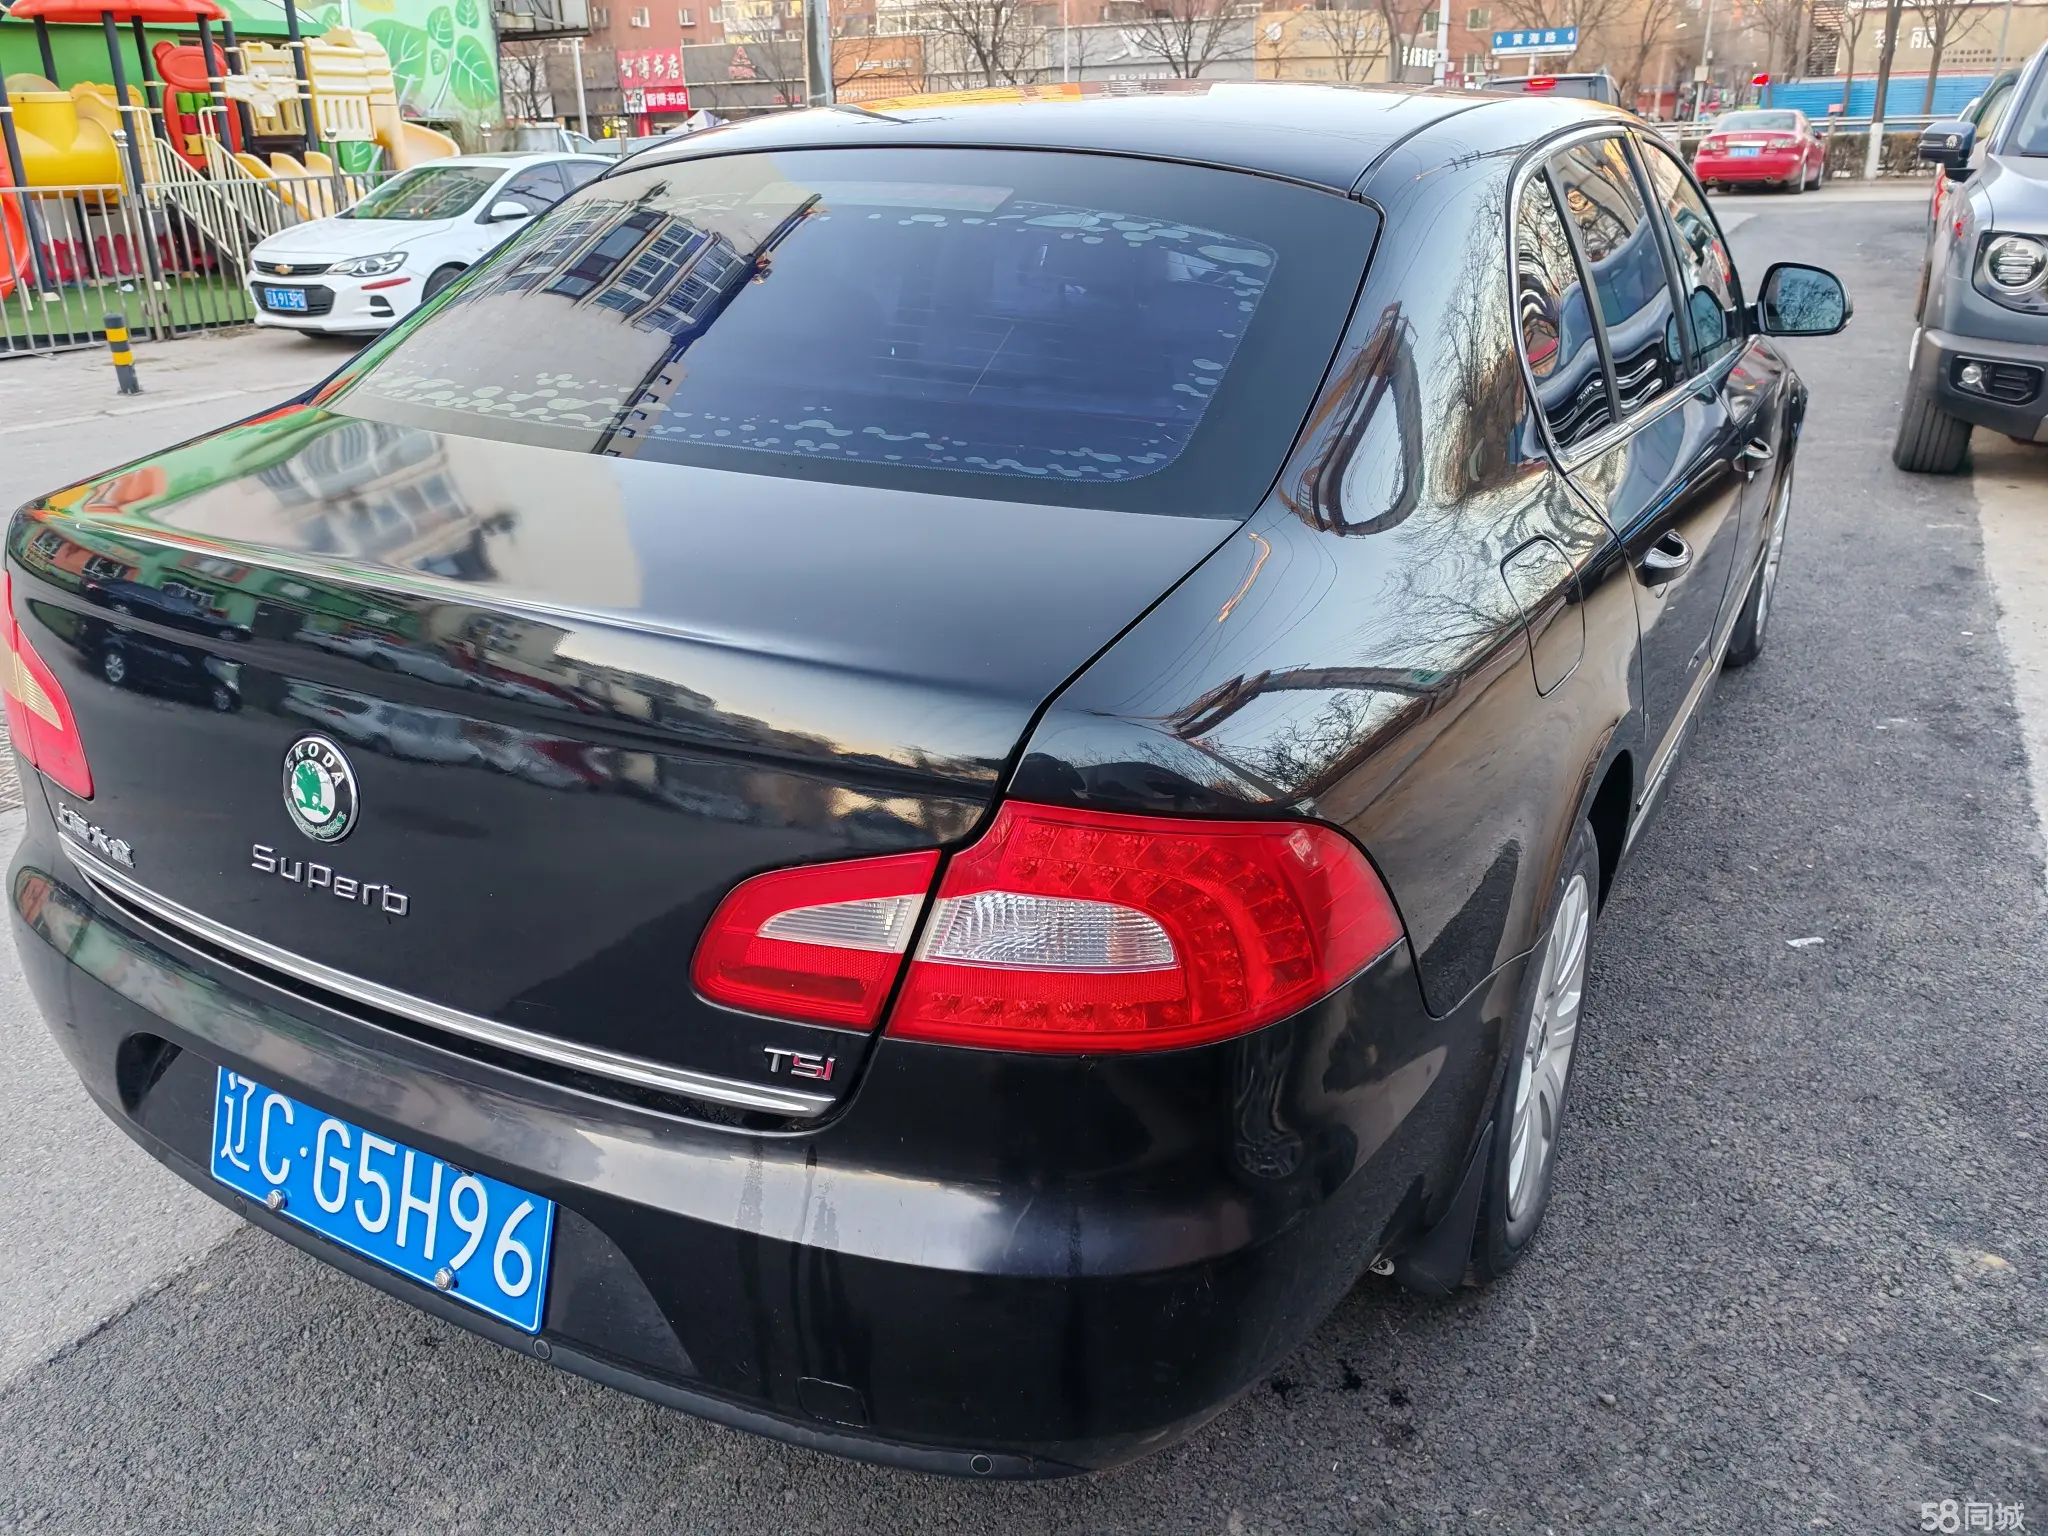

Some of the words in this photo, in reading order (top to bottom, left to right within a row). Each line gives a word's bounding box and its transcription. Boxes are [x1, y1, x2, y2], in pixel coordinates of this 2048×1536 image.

[1512, 31, 1557, 46] 黄海路
[58, 801, 136, 869] 上海大众
